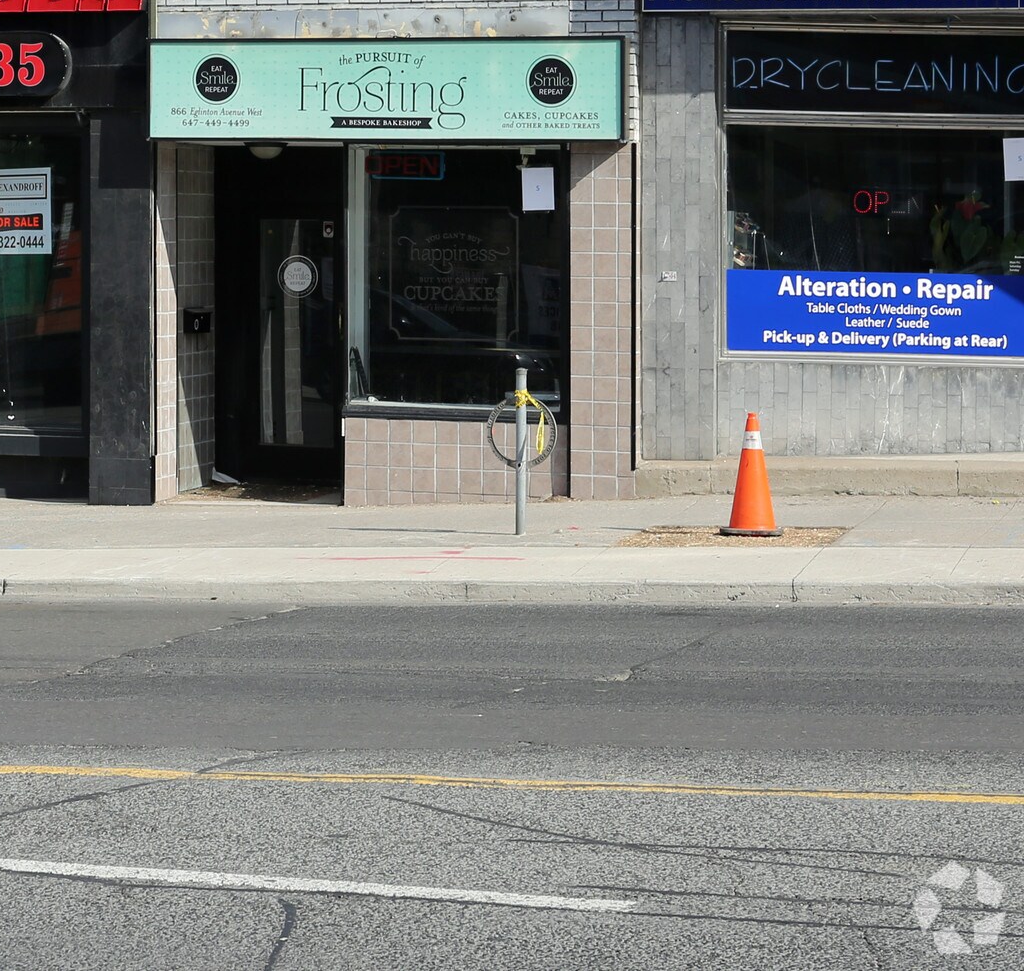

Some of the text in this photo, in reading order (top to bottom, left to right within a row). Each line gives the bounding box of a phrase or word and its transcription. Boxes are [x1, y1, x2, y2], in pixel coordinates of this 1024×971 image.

[339, 52, 427, 69] the PURSUIT of
[197, 71, 236, 86] Smile
[531, 72, 573, 87] Smile
[298, 66, 467, 129] Frosting
[170, 106, 263, 118] 866 Eglinton Avenue West
[504, 112, 599, 120] CAKES, CUPCAKES
[182, 119, 250, 127] 647-449-4499
[365, 155, 439, 176] OPEN
[14, 216, 39, 227] SALE
[402, 238, 508, 273] happiness
[778, 275, 994, 304] Alteration Repair
[806, 302, 835, 314] Table
[837, 303, 871, 315] Cloths
[879, 304, 928, 317] Wedding
[929, 305, 962, 317] Gown
[845, 317, 886, 328] Leather
[896, 317, 929, 329] Suede
[763, 330, 1008, 349] Pick-up & Delivery (Parking at Rear)
